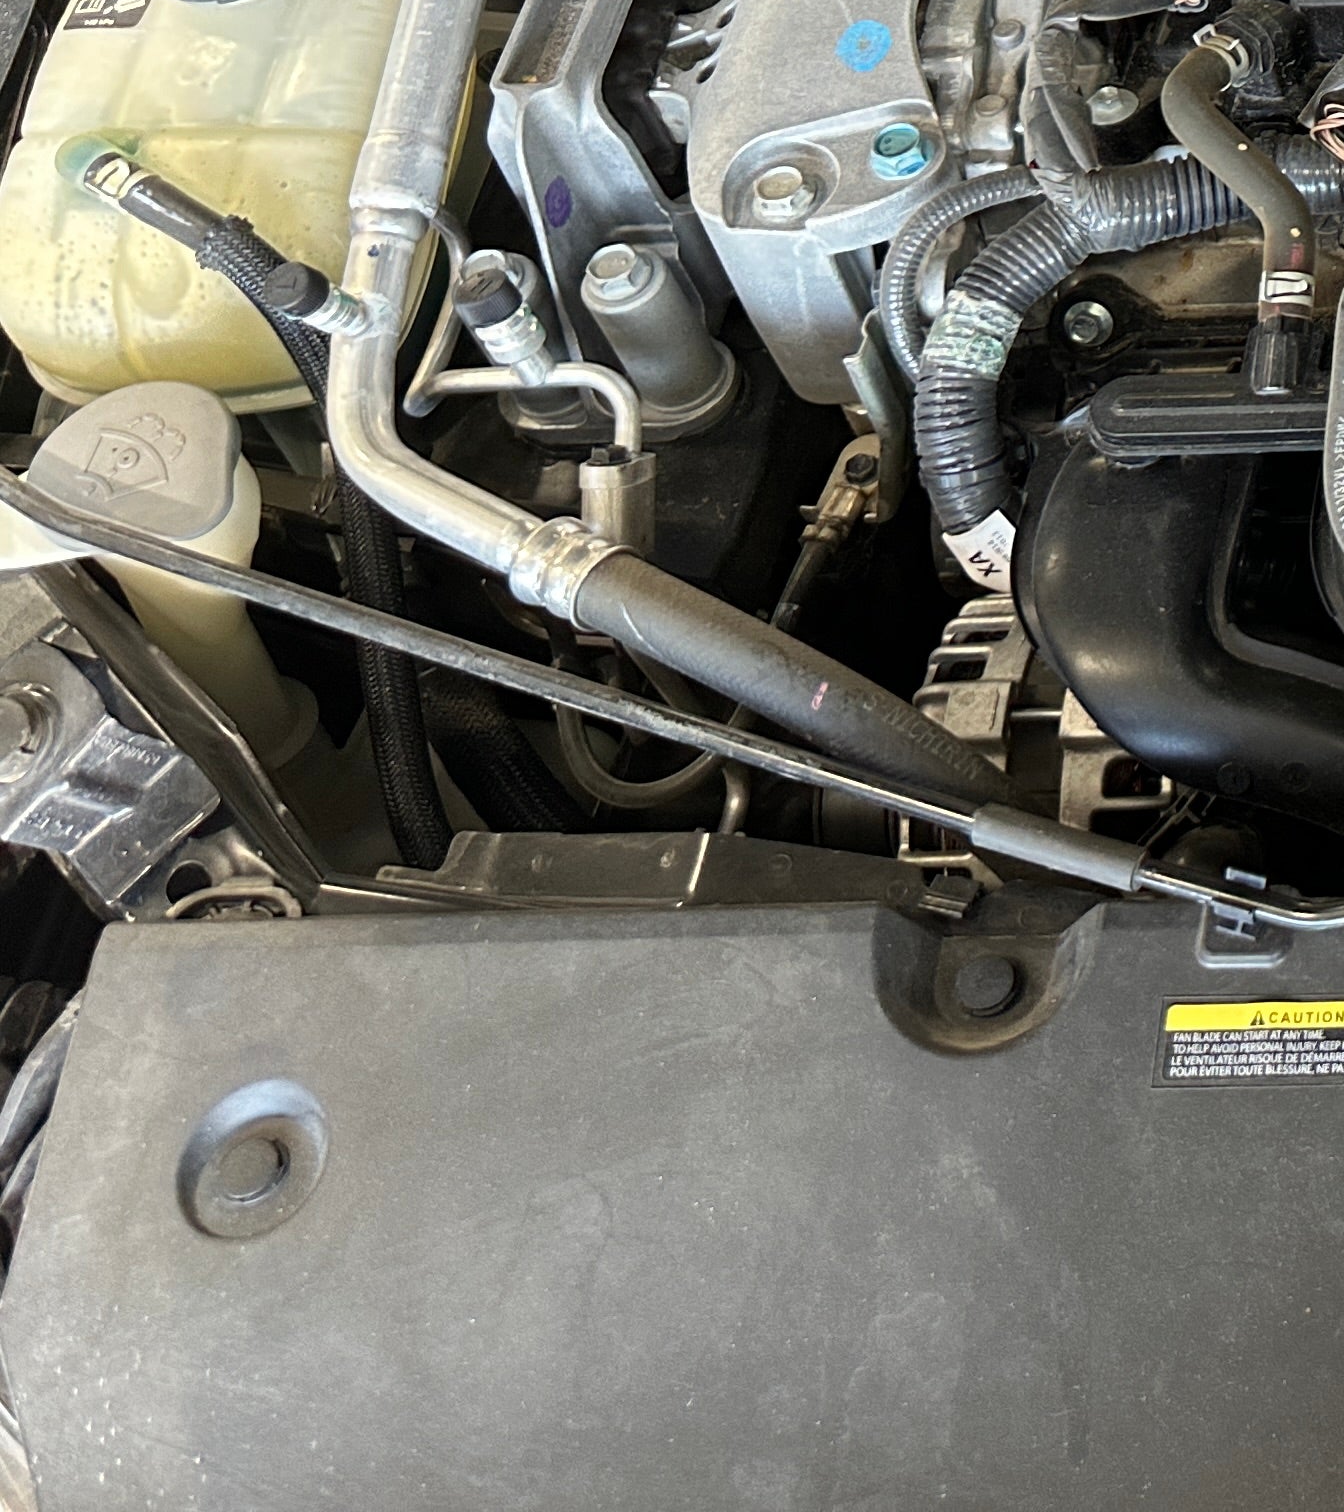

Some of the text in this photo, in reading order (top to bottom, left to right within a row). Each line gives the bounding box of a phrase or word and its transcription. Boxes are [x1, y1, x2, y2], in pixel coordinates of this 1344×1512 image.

[968, 551, 1003, 577] XA
[1268, 1010, 1344, 1024] CAUTION
[1173, 1032, 1192, 1042] FAN
[1192, 1031, 1221, 1041] BLADE
[1222, 1031, 1242, 1041] CAN
[1243, 1030, 1270, 1040] START
[1270, 1030, 1282, 1040] AT
[1282, 1029, 1303, 1039] ANY
[1173, 1044, 1187, 1054] TO
[1187, 1043, 1210, 1054] HELP
[1211, 1042, 1239, 1053] AVOID
[1240, 1042, 1284, 1052] PERSONAL
[1319, 1040, 1341, 1051] KEEP
[1171, 1055, 1183, 1066] LE
[1183, 1054, 1248, 1065] VENTILATEUR
[1249, 1053, 1284, 1064] RISQUE
[1285, 1052, 1298, 1063] DE
[1169, 1066, 1198, 1077] POUR
[1232, 1064, 1263, 1076] TOUTE
[1316, 1063, 1330, 1074] NE
